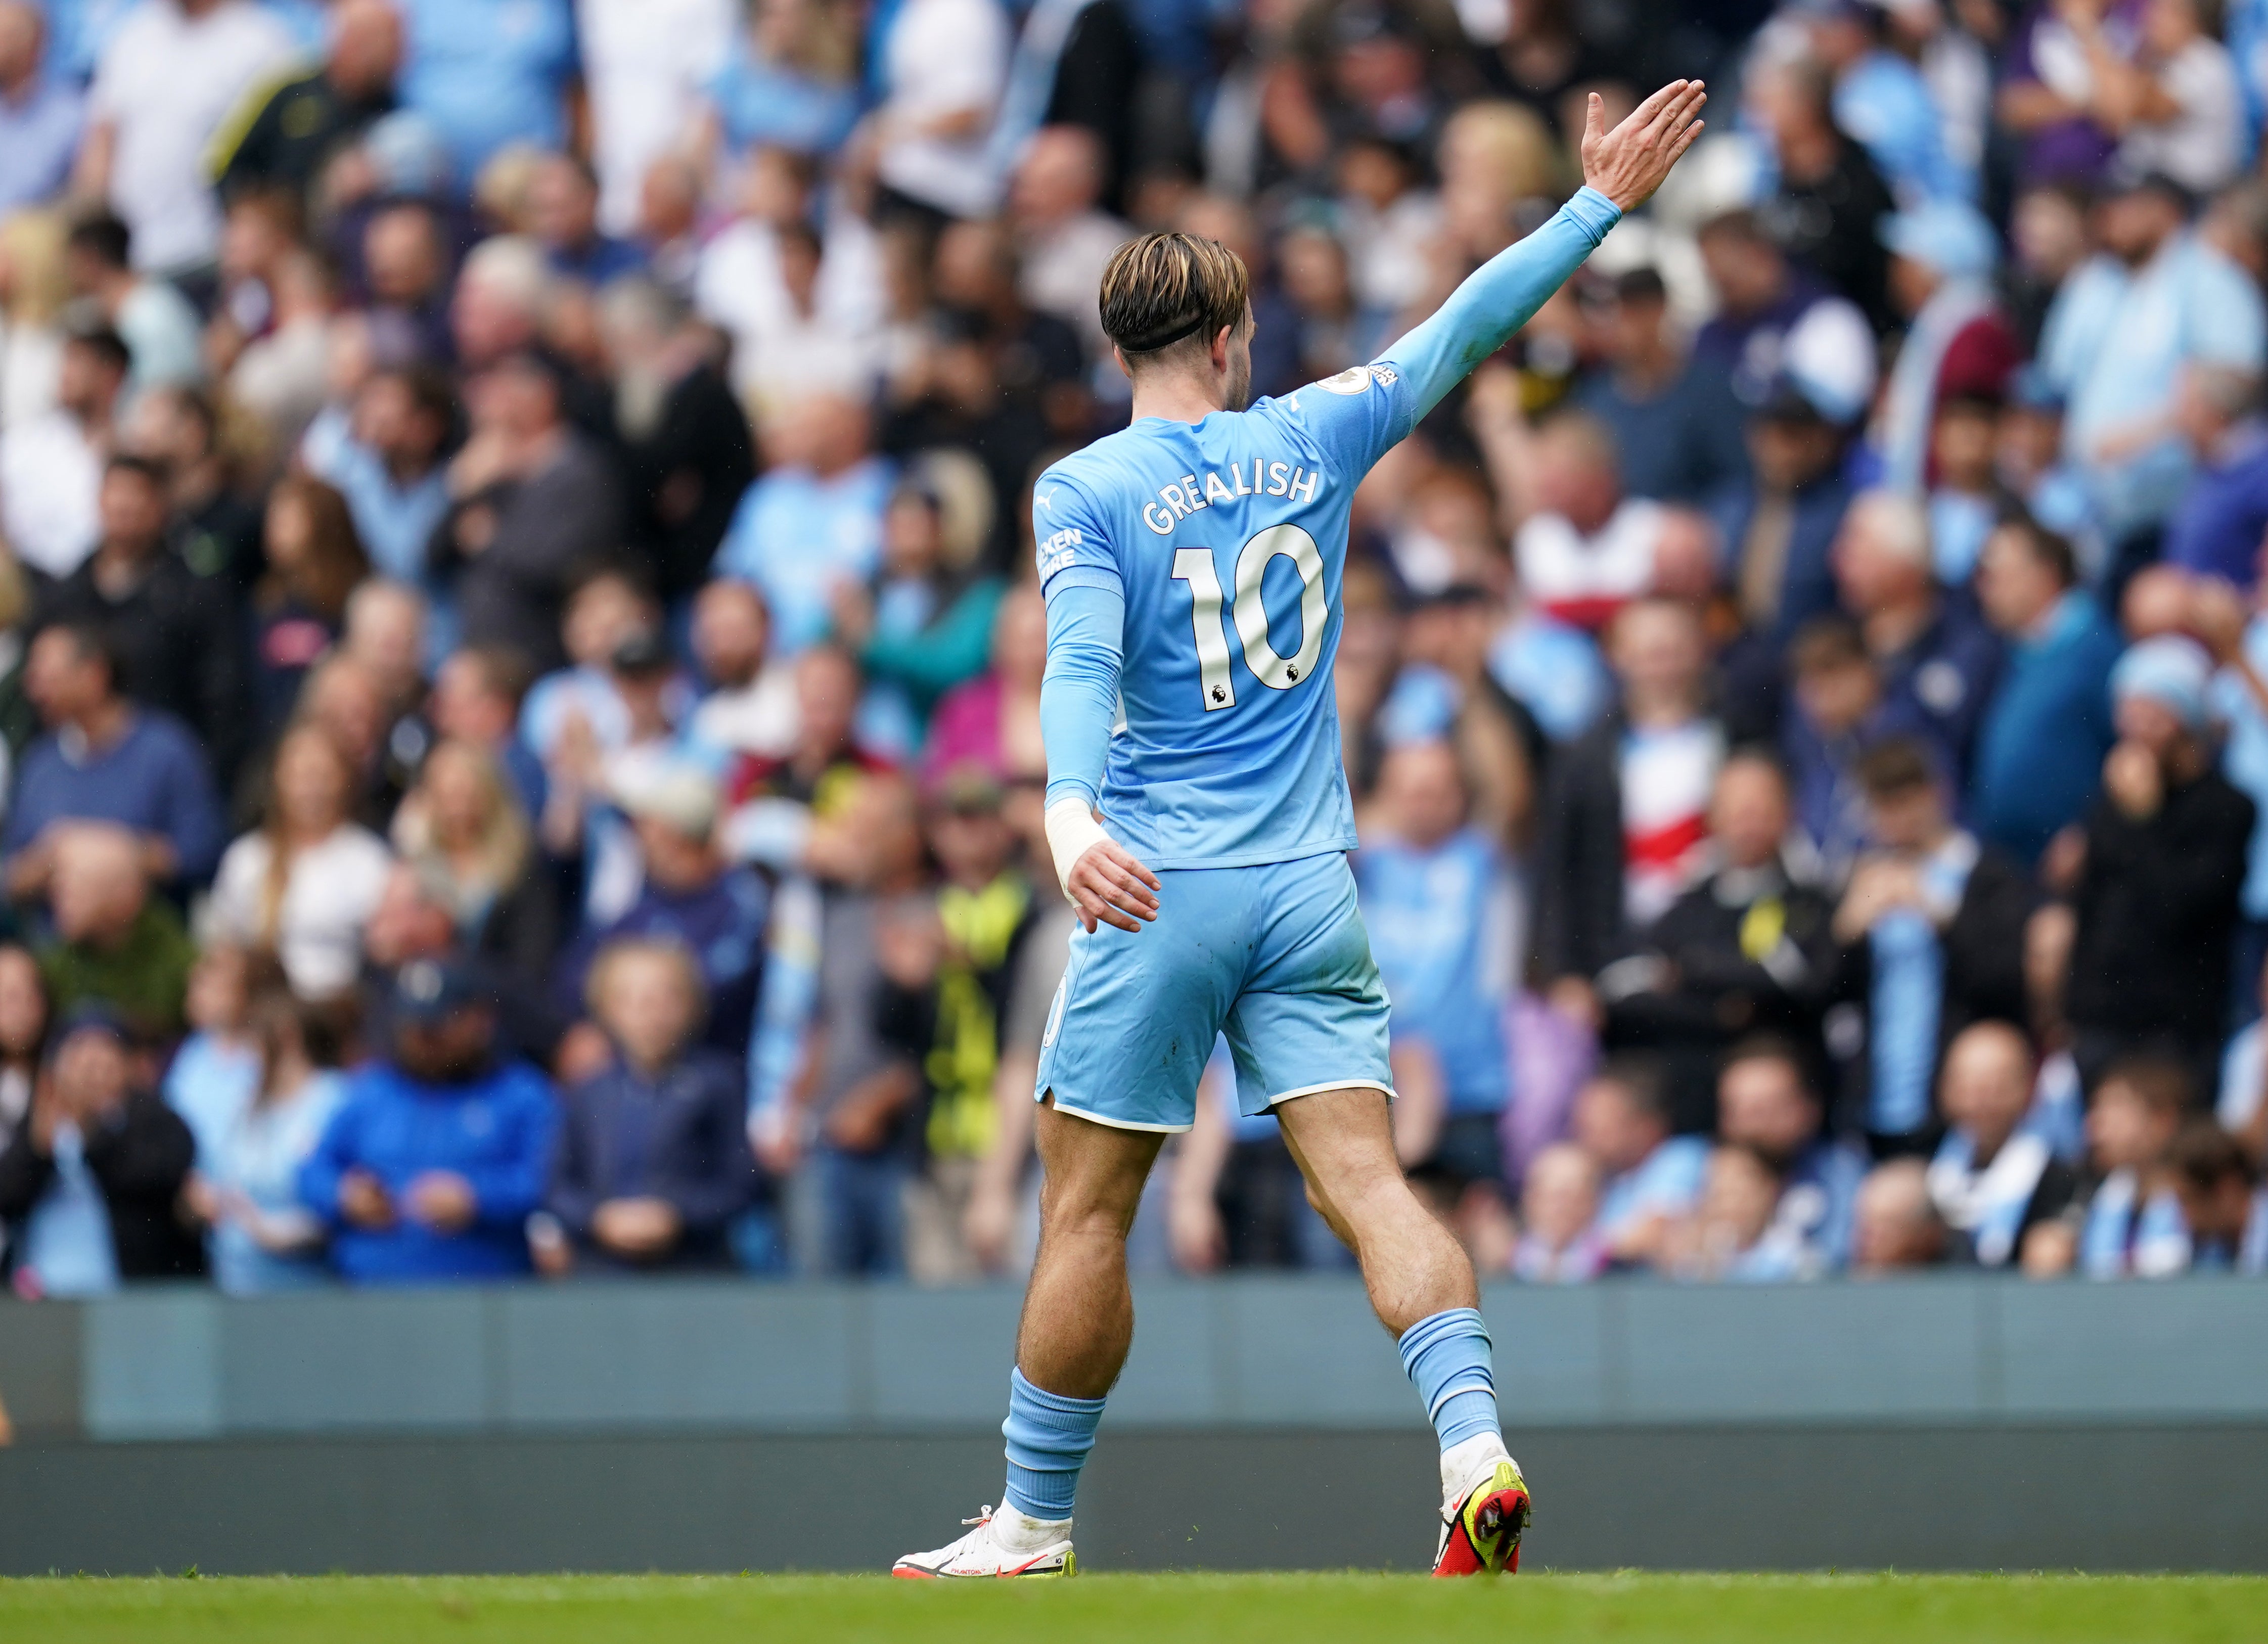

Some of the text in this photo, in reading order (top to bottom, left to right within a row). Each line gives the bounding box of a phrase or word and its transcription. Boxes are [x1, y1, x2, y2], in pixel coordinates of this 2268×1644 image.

[1143, 458, 1318, 535] GREALISH
[1041, 549, 1075, 585] TIRE
[1170, 523, 1329, 712] 10
